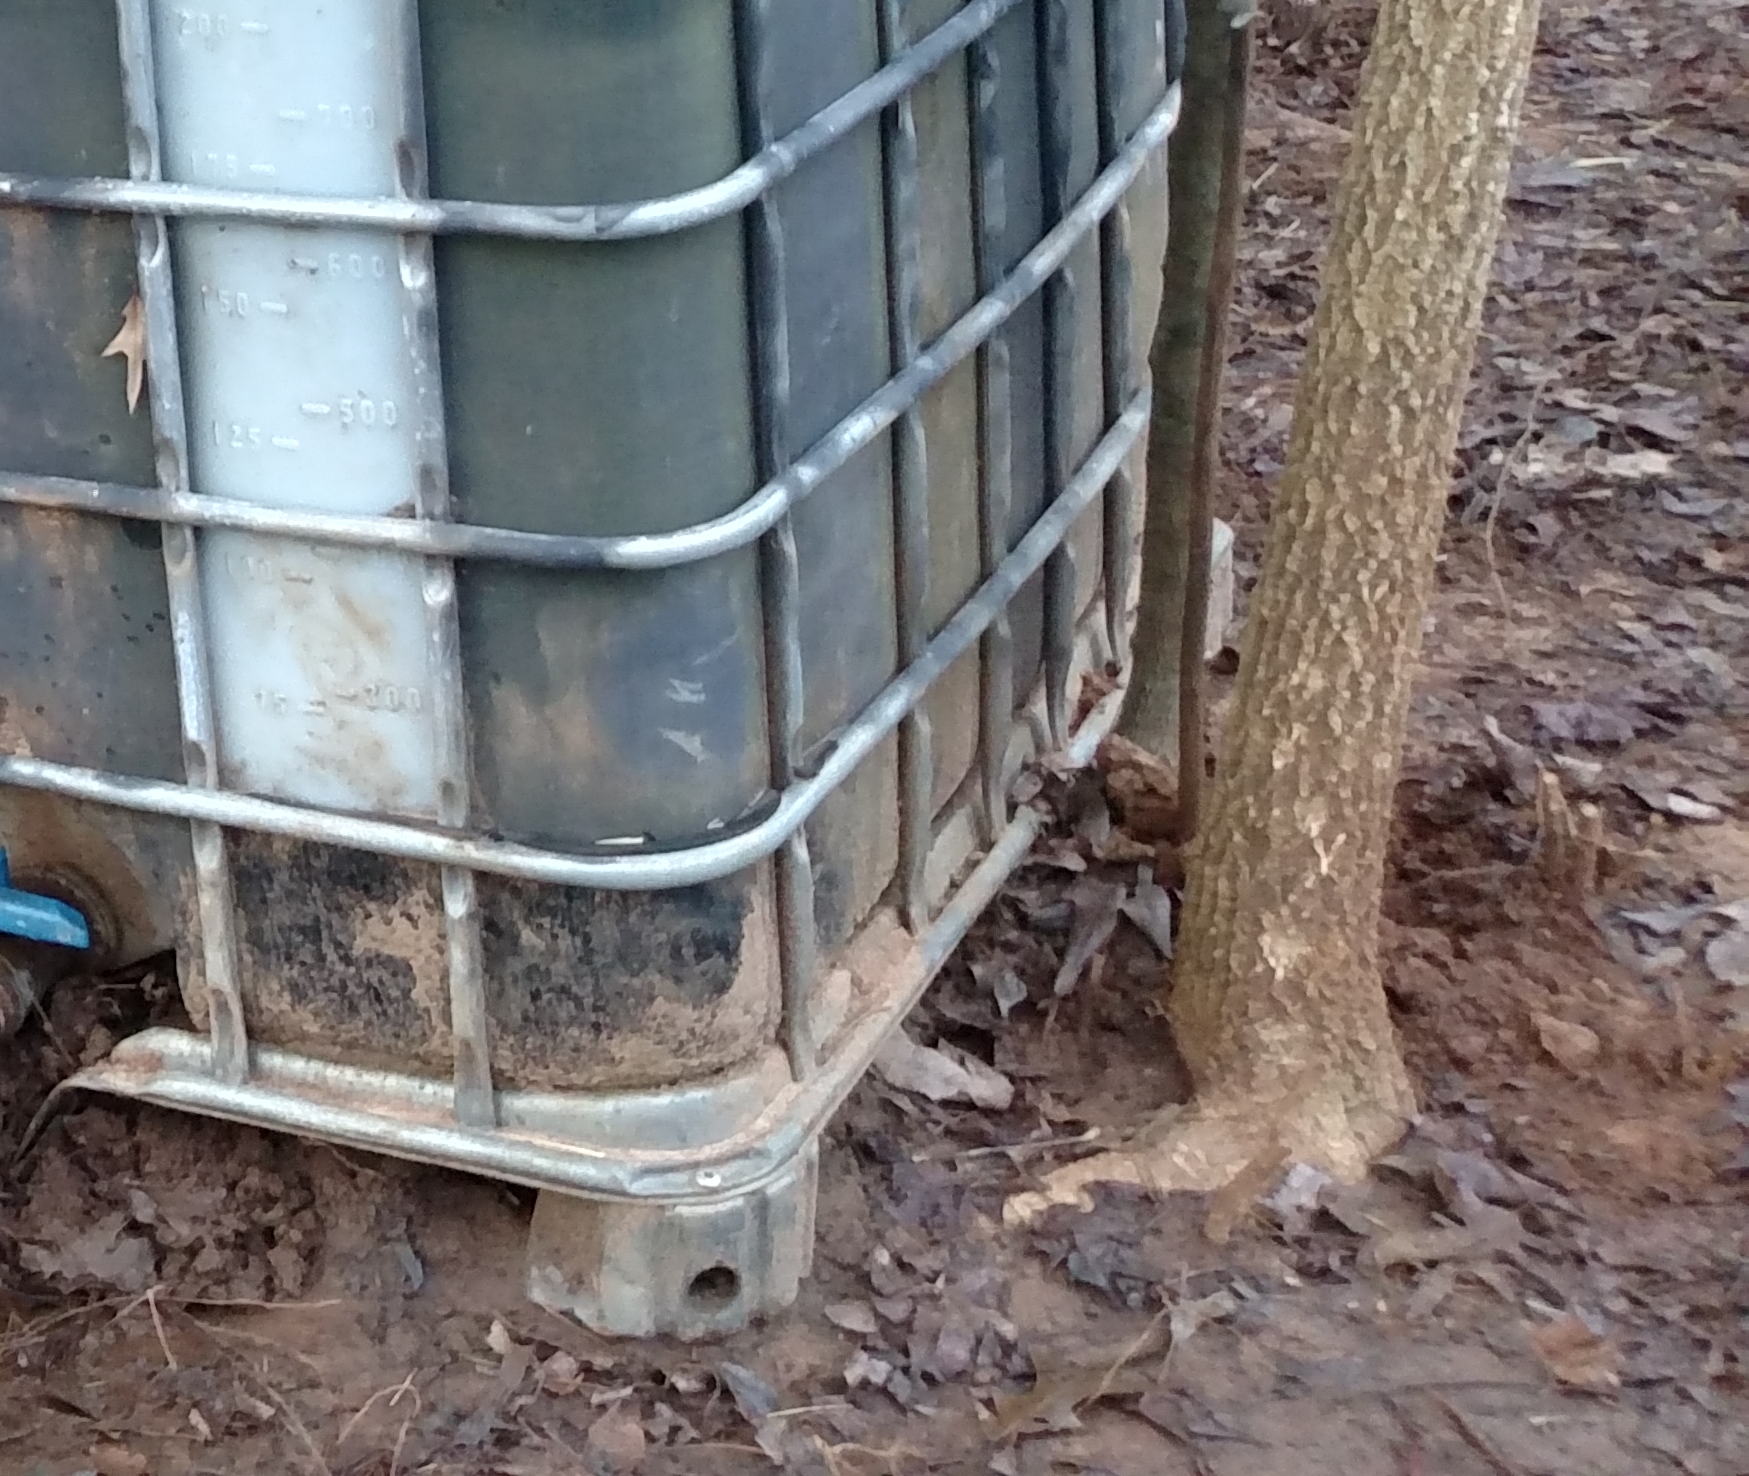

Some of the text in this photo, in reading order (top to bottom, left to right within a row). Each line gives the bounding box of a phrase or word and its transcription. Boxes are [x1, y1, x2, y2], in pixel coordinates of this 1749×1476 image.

[328, 251, 386, 279] 600
[338, 397, 398, 427] 500
[212, 420, 262, 450] 125
